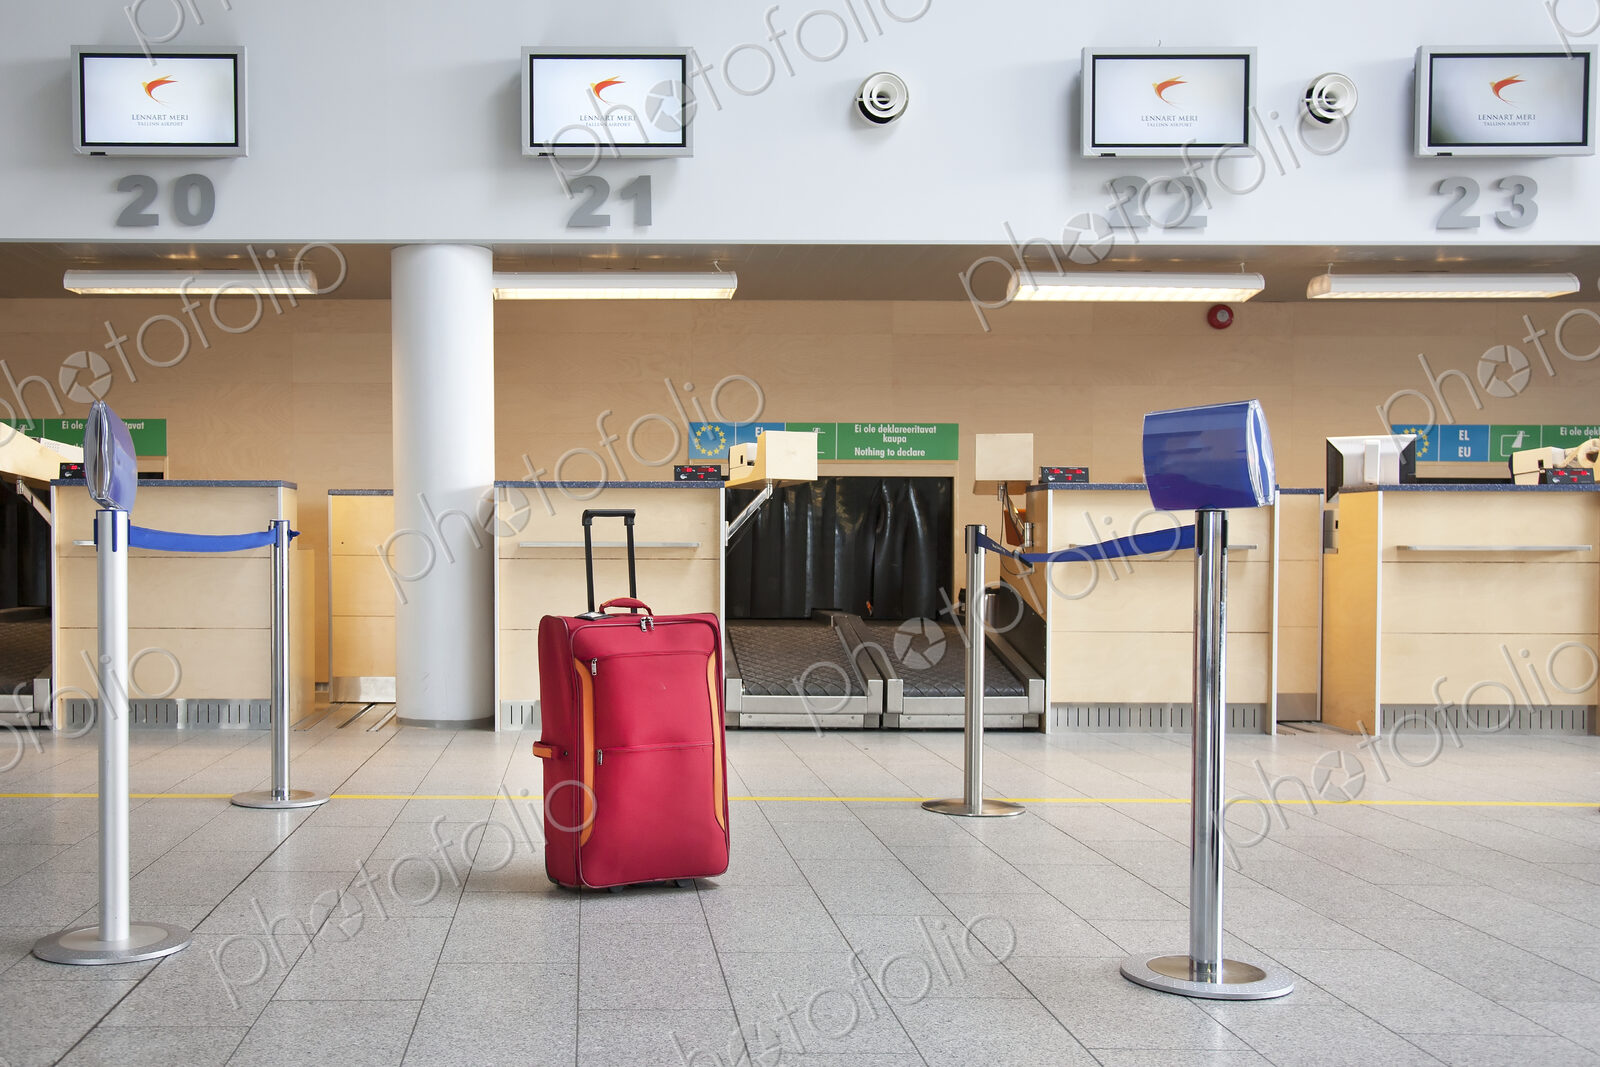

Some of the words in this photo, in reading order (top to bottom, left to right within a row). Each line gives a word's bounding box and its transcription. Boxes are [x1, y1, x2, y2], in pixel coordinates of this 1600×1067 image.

[131, 113, 167, 121] LENNART
[169, 113, 189, 121] MERI
[1478, 113, 1513, 121] LENNART
[1516, 113, 1537, 121] MERI
[115, 173, 215, 227] 20
[567, 174, 652, 228] 21
[1105, 175, 1207, 229] 22
[1435, 174, 1538, 229] 23
[62, 421, 69, 430] Ei
[71, 420, 83, 430] ole
[854, 424, 862, 433] Ei
[863, 423, 876, 433] ole
[878, 423, 937, 434] deklareeritavat
[1458, 429, 1470, 441] EL
[1569, 426, 1582, 436] ole
[882, 433, 907, 444] kaupa
[854, 447, 885, 458] Nothing
[887, 448, 895, 456] to
[897, 447, 926, 457] declare
[1458, 446, 1471, 458] EU
